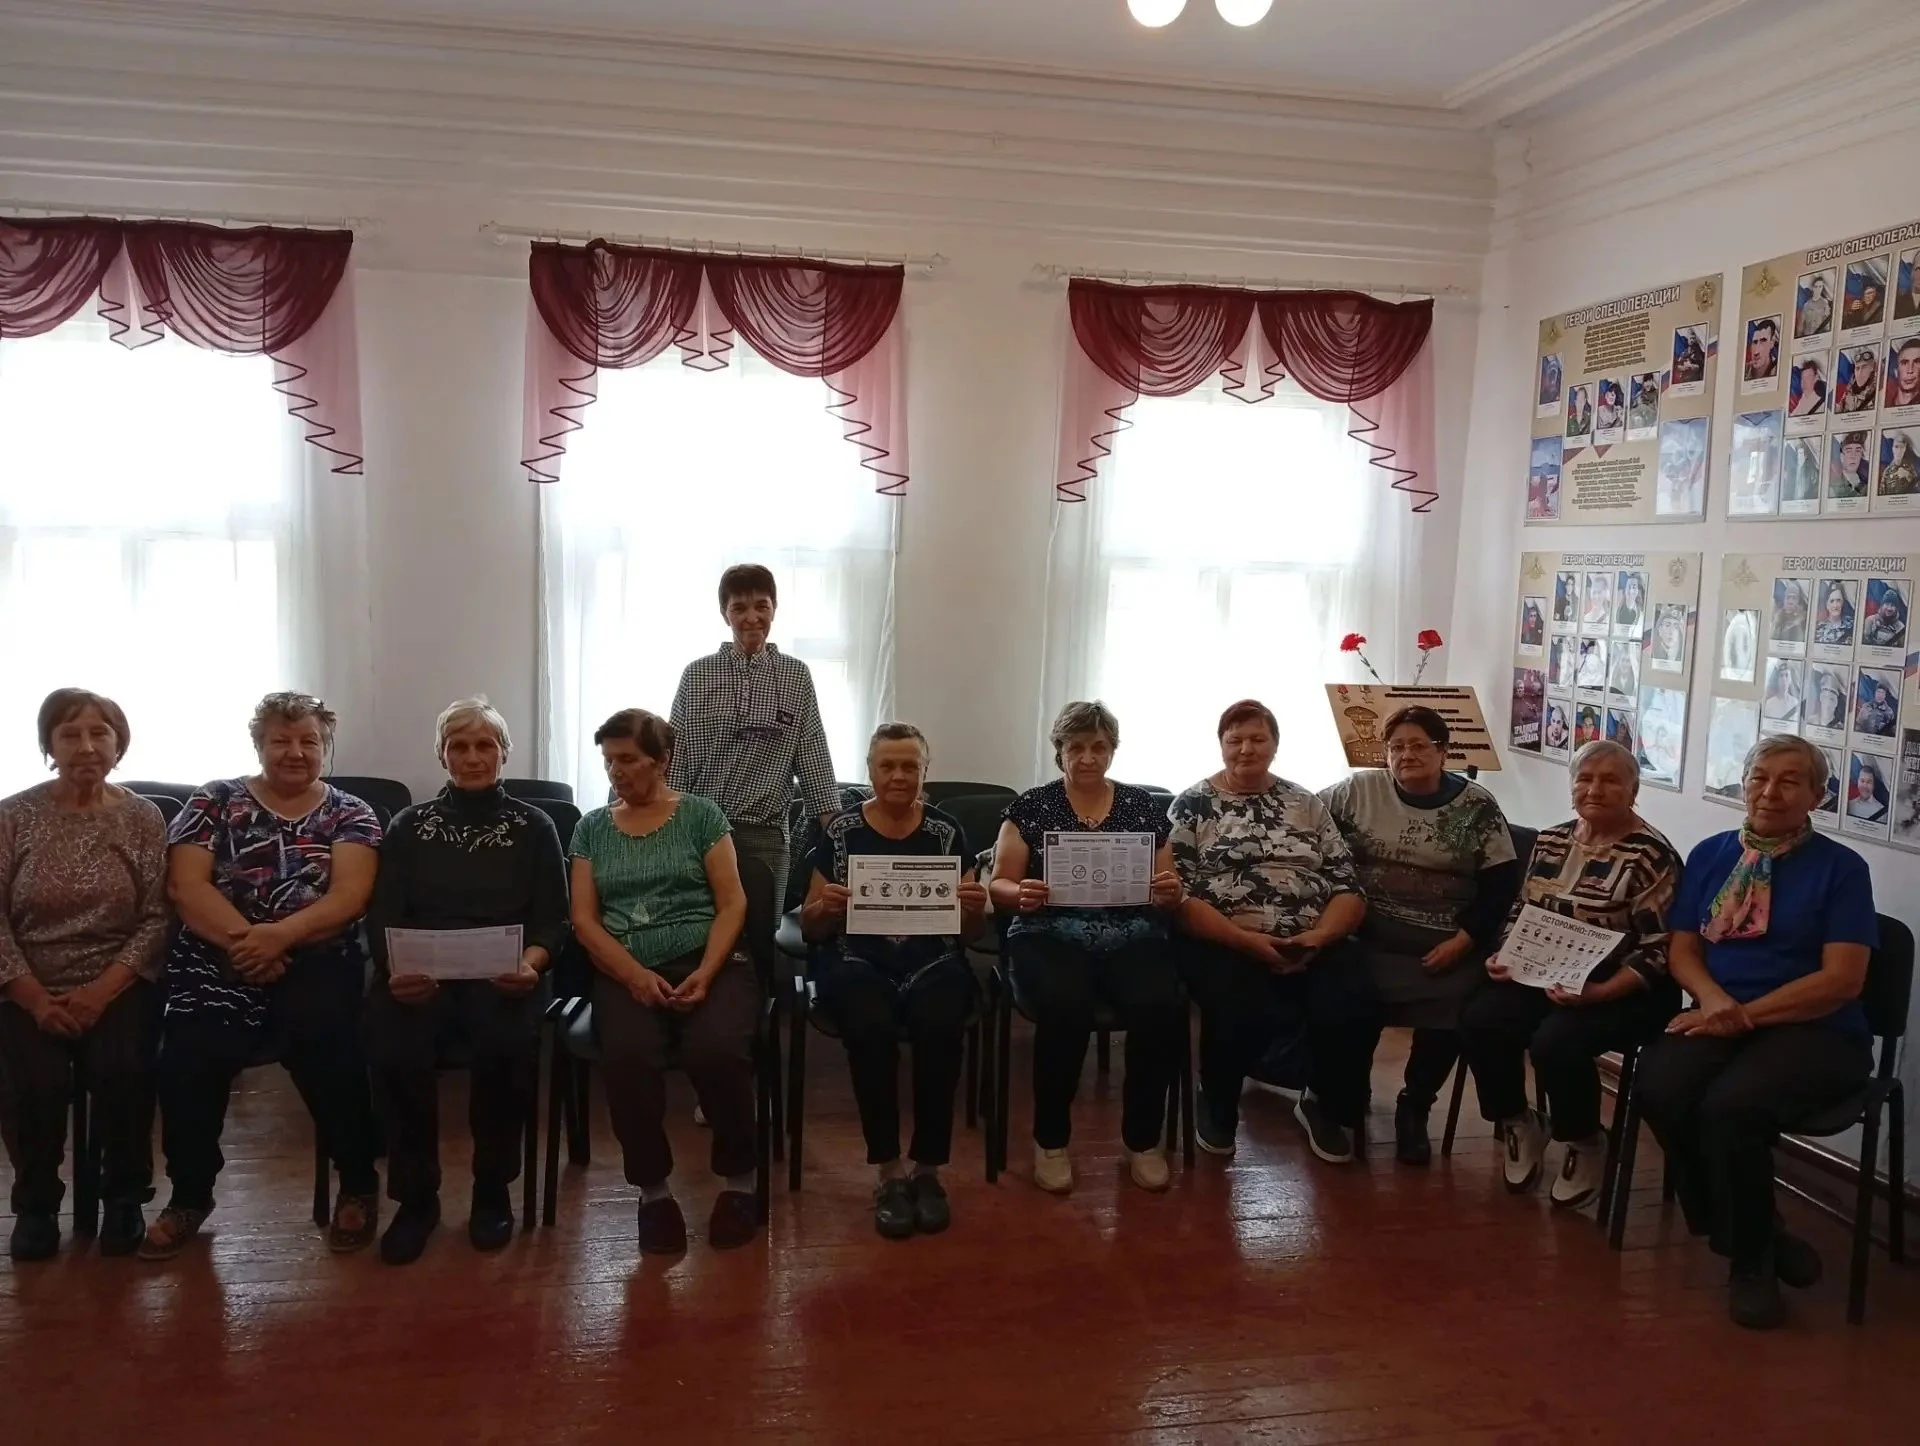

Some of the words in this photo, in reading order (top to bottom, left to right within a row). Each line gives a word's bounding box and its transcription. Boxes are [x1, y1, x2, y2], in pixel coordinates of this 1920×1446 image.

[1806, 243, 1842, 265] ГЕРОИ
[1564, 307, 1593, 329] ГЕРОИ
[1594, 285, 1680, 321] СПЕЦОПЕРАЦИИ
[1782, 556, 1815, 570] ГЕРОИ
[1816, 556, 1906, 573] СПЕЦОПЕРАЦИИ
